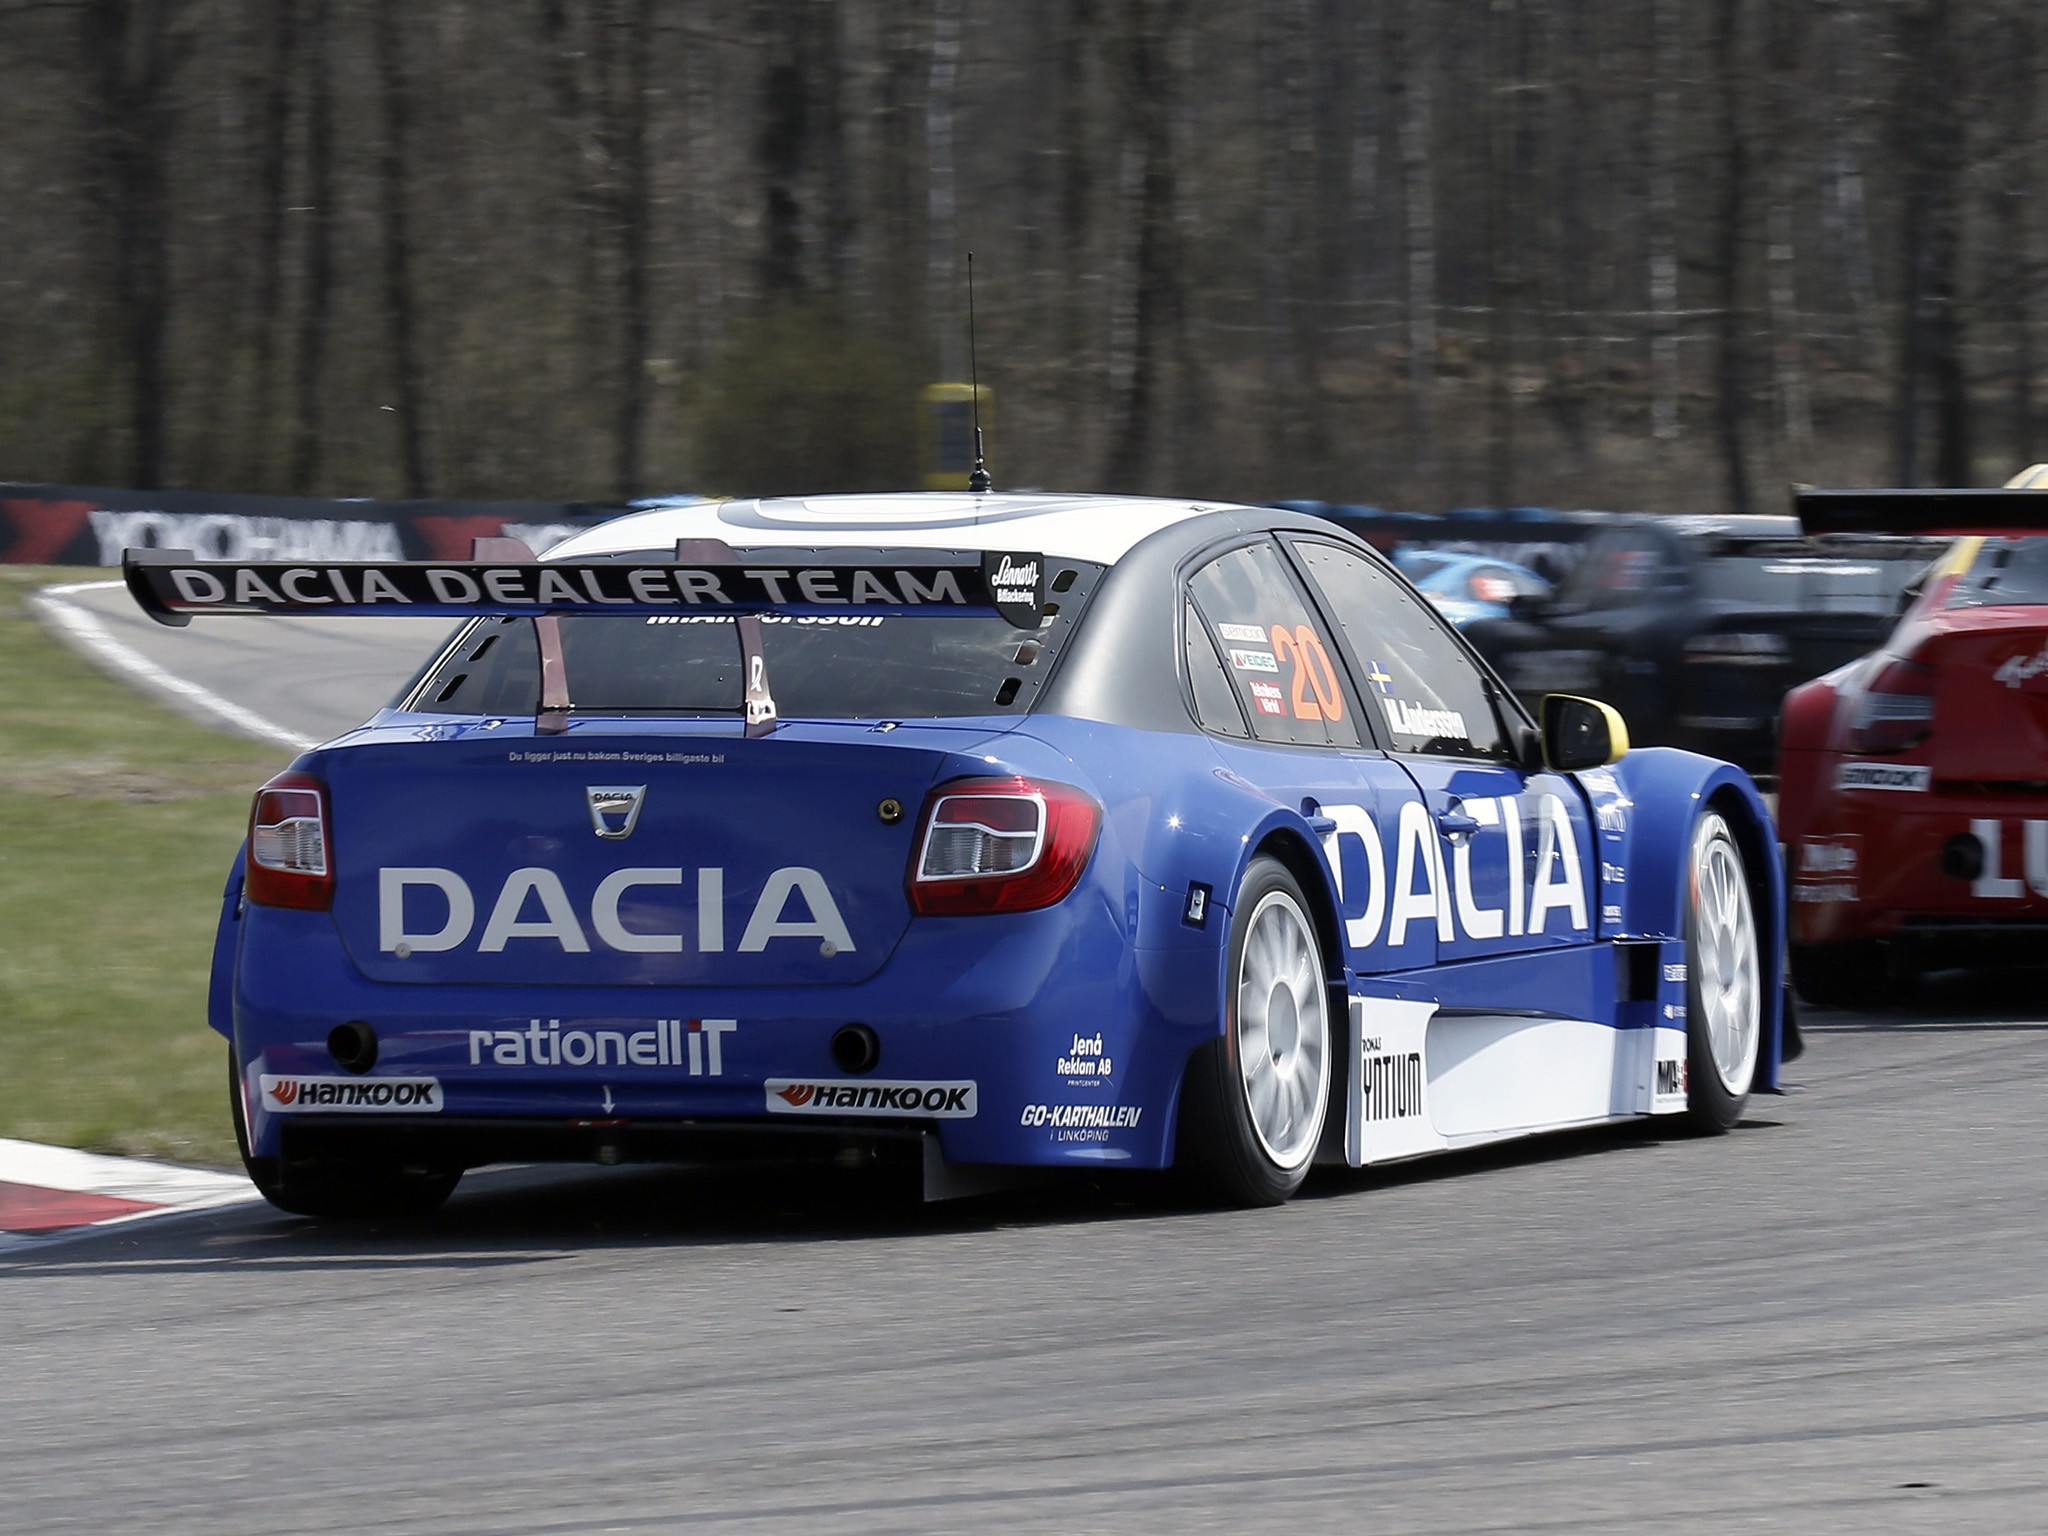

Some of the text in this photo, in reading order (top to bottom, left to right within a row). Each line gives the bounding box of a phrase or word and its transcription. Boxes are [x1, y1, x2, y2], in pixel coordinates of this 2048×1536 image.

[170, 568, 967, 605] DACIA DEALER TEAM
[1270, 624, 1343, 722] 20
[509, 752, 522, 761] Du
[552, 751, 572, 762] just
[587, 751, 621, 760] bakom
[622, 751, 664, 763] Sveriges
[666, 753, 710, 764] billigaste
[712, 754, 725, 763] bil
[593, 792, 633, 801] DACIA
[1320, 792, 1589, 949] DACIA
[379, 867, 856, 954] DACIA
[1057, 1057, 1112, 1075] Reklam AB
[1020, 1104, 1143, 1128] GO-KARTHALLEN
[1058, 1129, 1110, 1142] LINKÖPING
